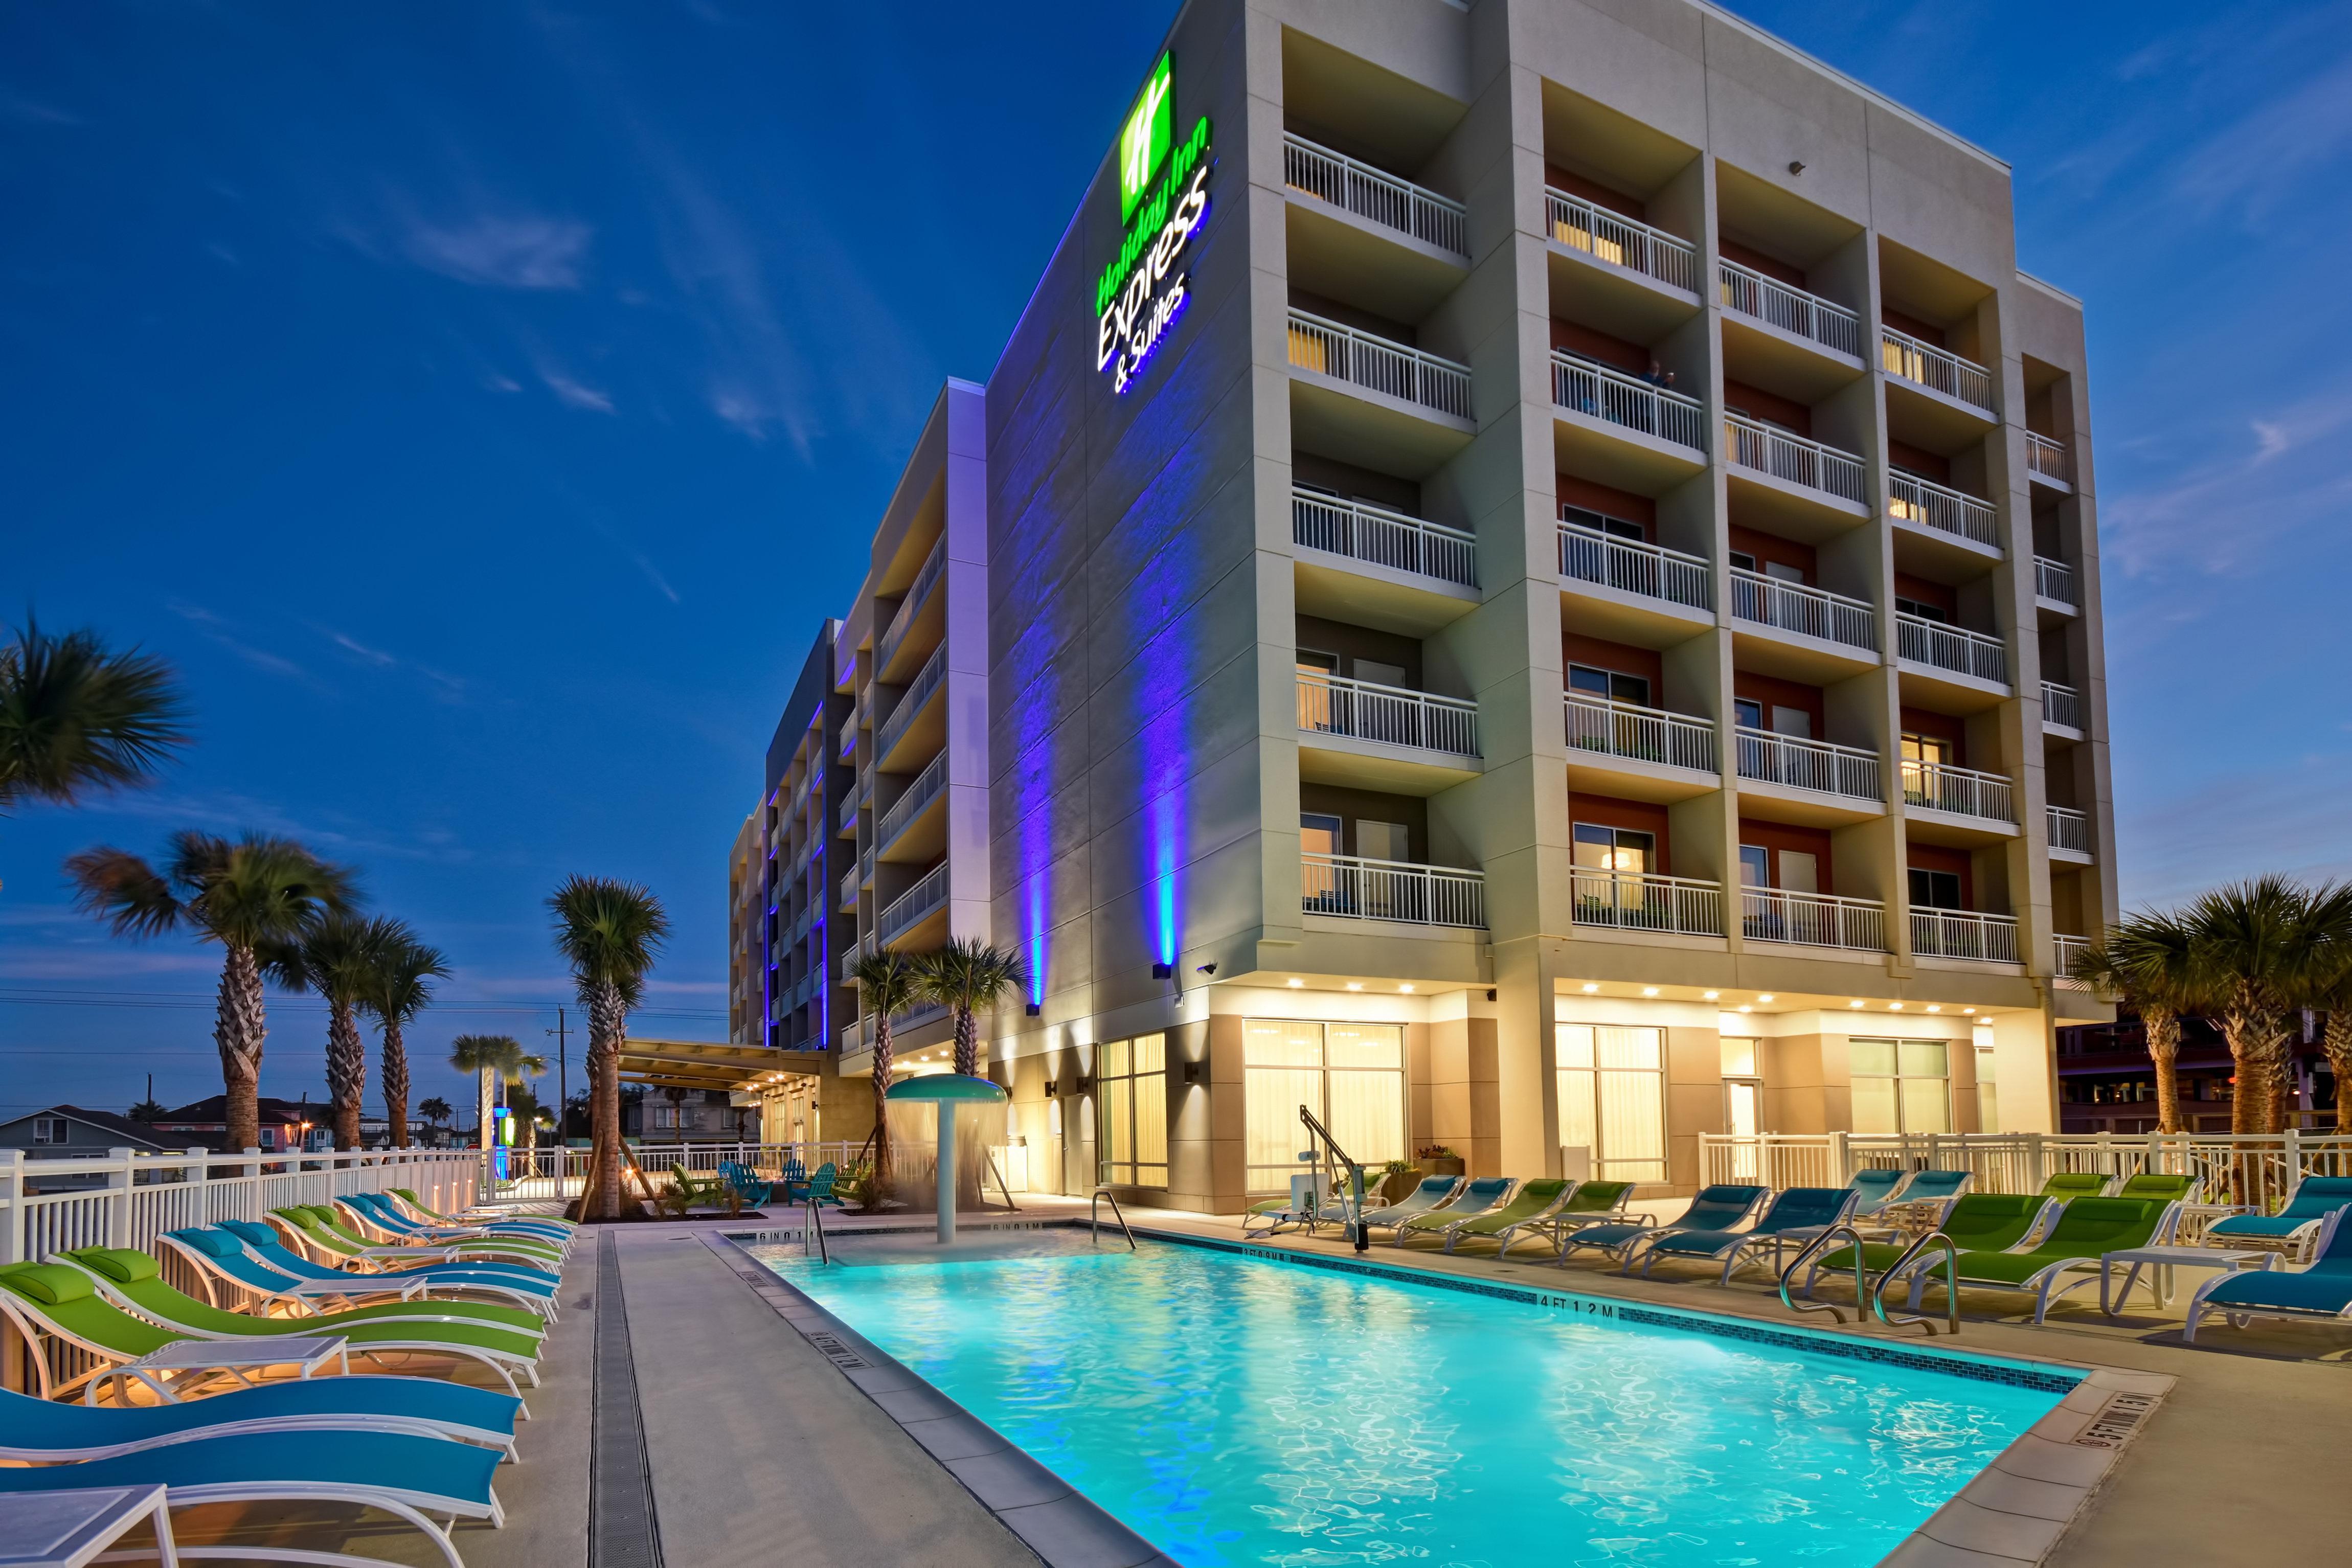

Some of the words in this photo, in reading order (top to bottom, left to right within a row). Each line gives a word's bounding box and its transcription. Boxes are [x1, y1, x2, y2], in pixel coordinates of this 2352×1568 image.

[1096, 177, 1169, 317] Holiday
[1171, 116, 1208, 195] Inn
[1098, 165, 1207, 372] Express
[1115, 354, 1127, 394] &
[1130, 272, 1185, 372] Suites
[1541, 1295, 1548, 1307] 4
[1553, 1297, 1567, 1309] FT
[1602, 1305, 1613, 1318] M
